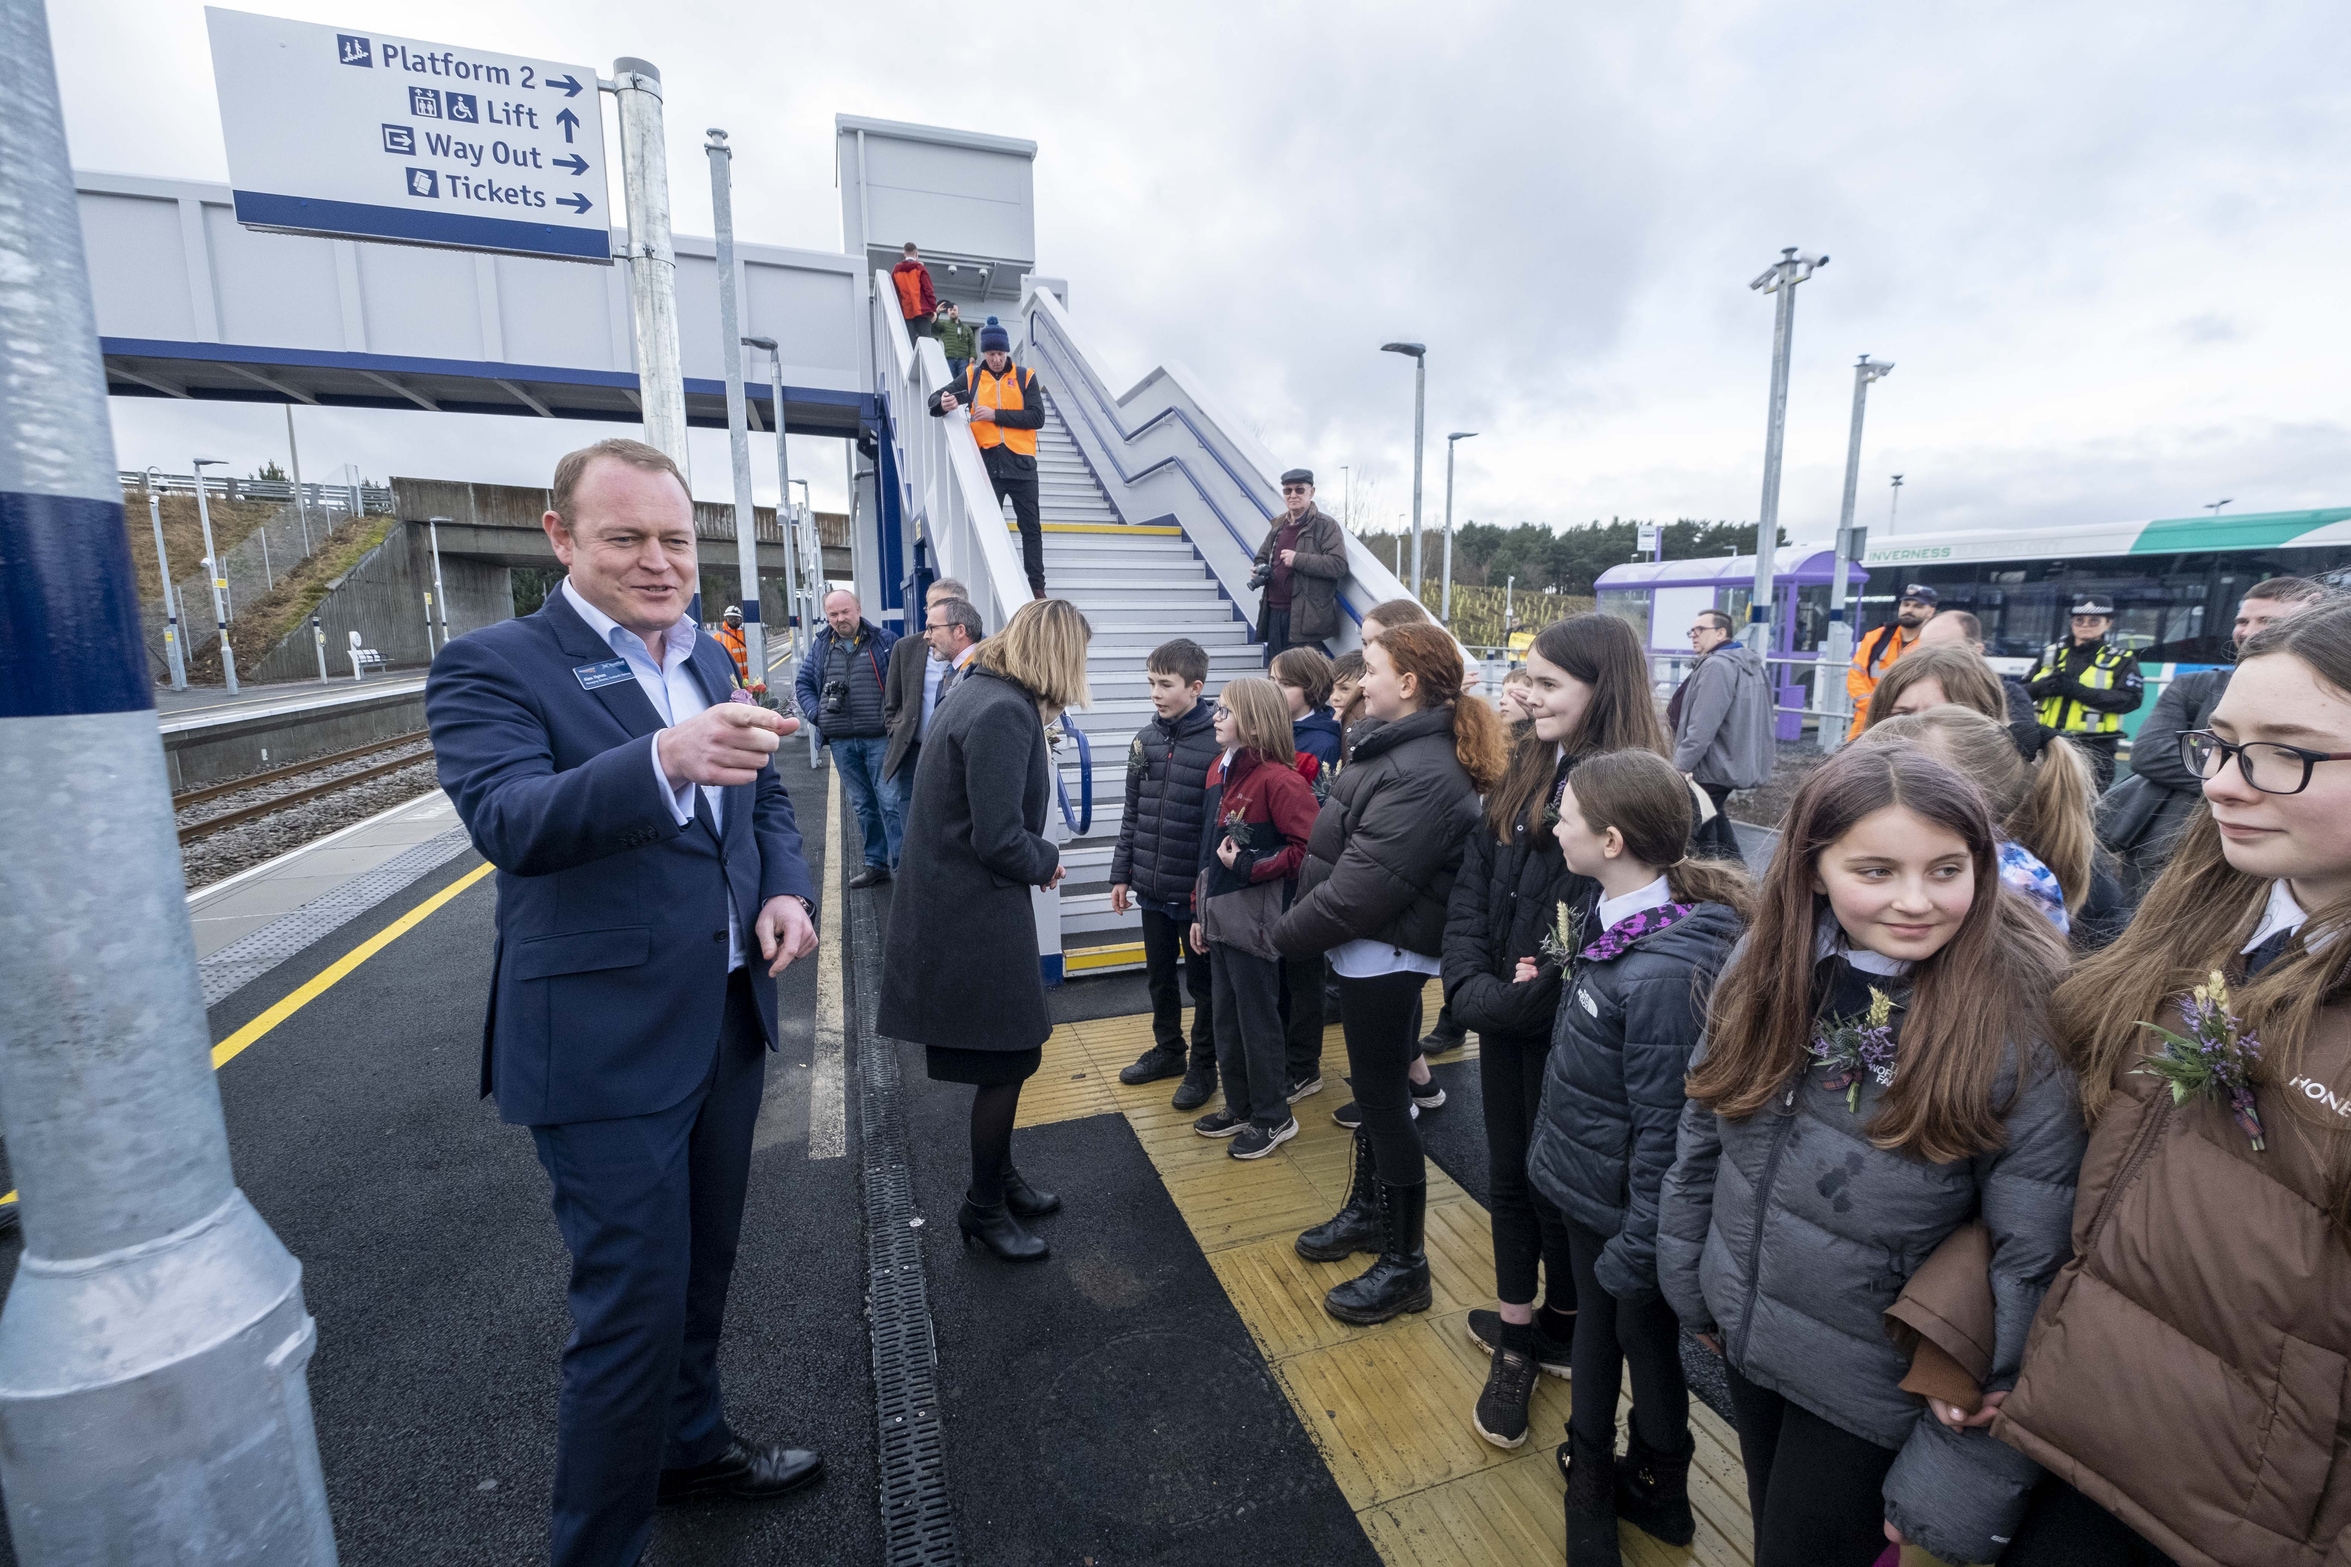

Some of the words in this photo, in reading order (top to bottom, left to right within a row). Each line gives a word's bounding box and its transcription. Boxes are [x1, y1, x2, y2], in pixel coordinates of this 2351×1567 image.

[382, 43, 510, 86] Platform
[520, 65, 536, 90] 2
[487, 100, 540, 130] Lift
[425, 131, 484, 168] Way
[492, 140, 543, 170] Out
[445, 174, 546, 208] Tickets
[1868, 547, 1952, 561] INVERNESS
